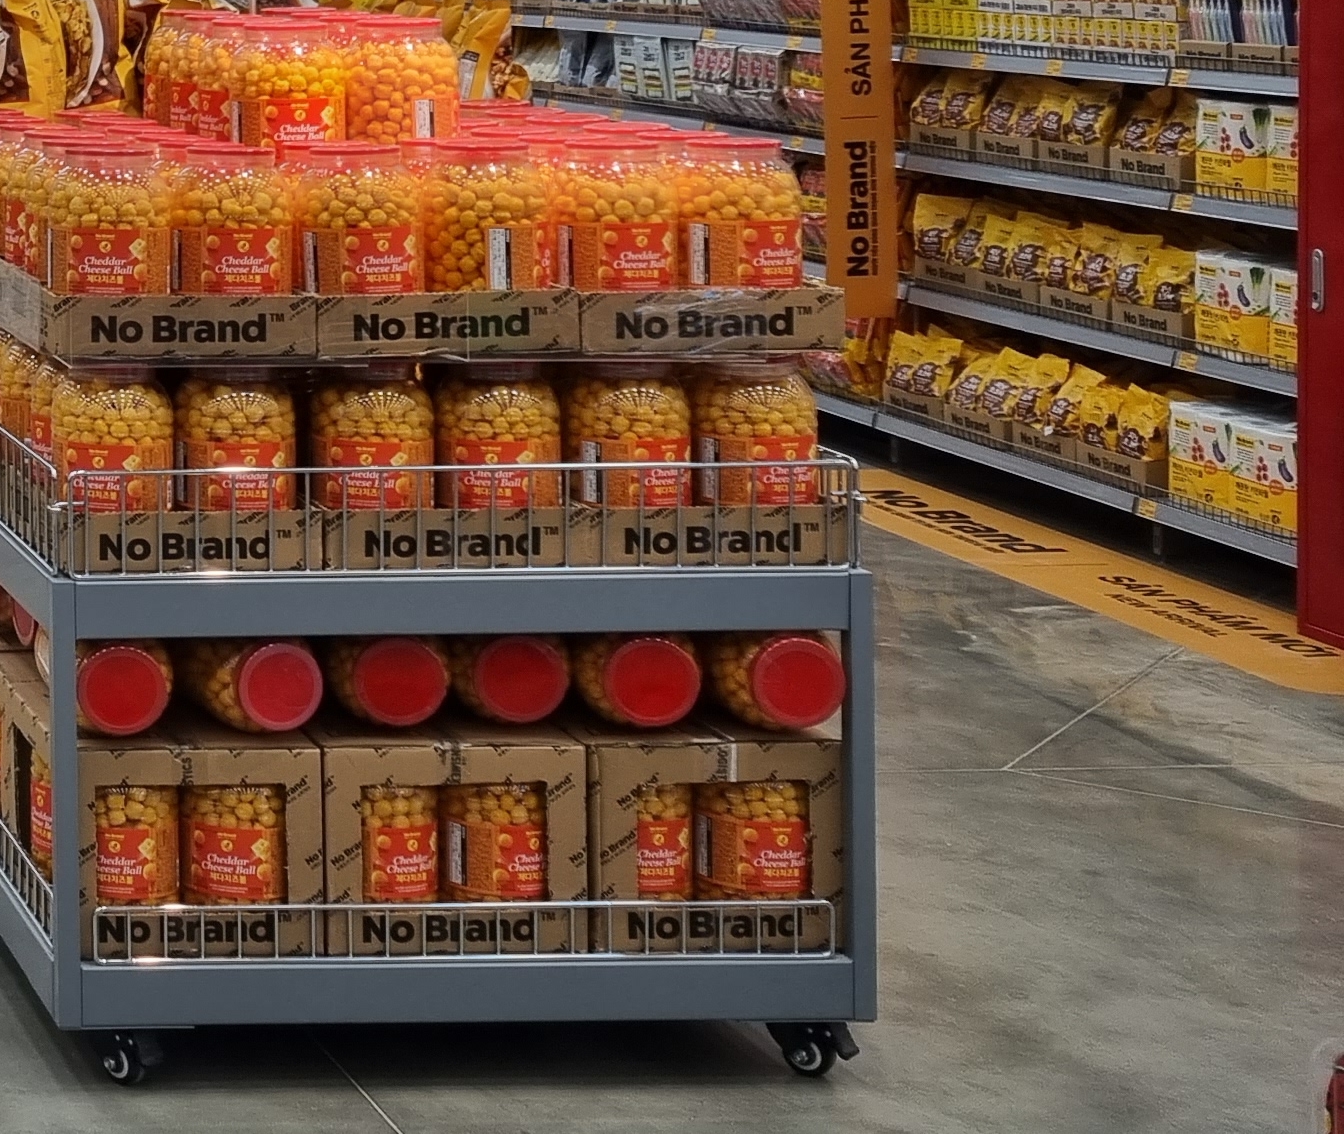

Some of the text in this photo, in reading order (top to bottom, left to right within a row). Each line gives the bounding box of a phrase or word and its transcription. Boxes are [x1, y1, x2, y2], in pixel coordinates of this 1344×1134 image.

[844, 41, 871, 97] SẢN
[844, 140, 870, 278] No Brand
[78, 264, 133, 275] Cheese Ball
[84, 256, 127, 266] Cheddar
[90, 312, 267, 344] No Brand
